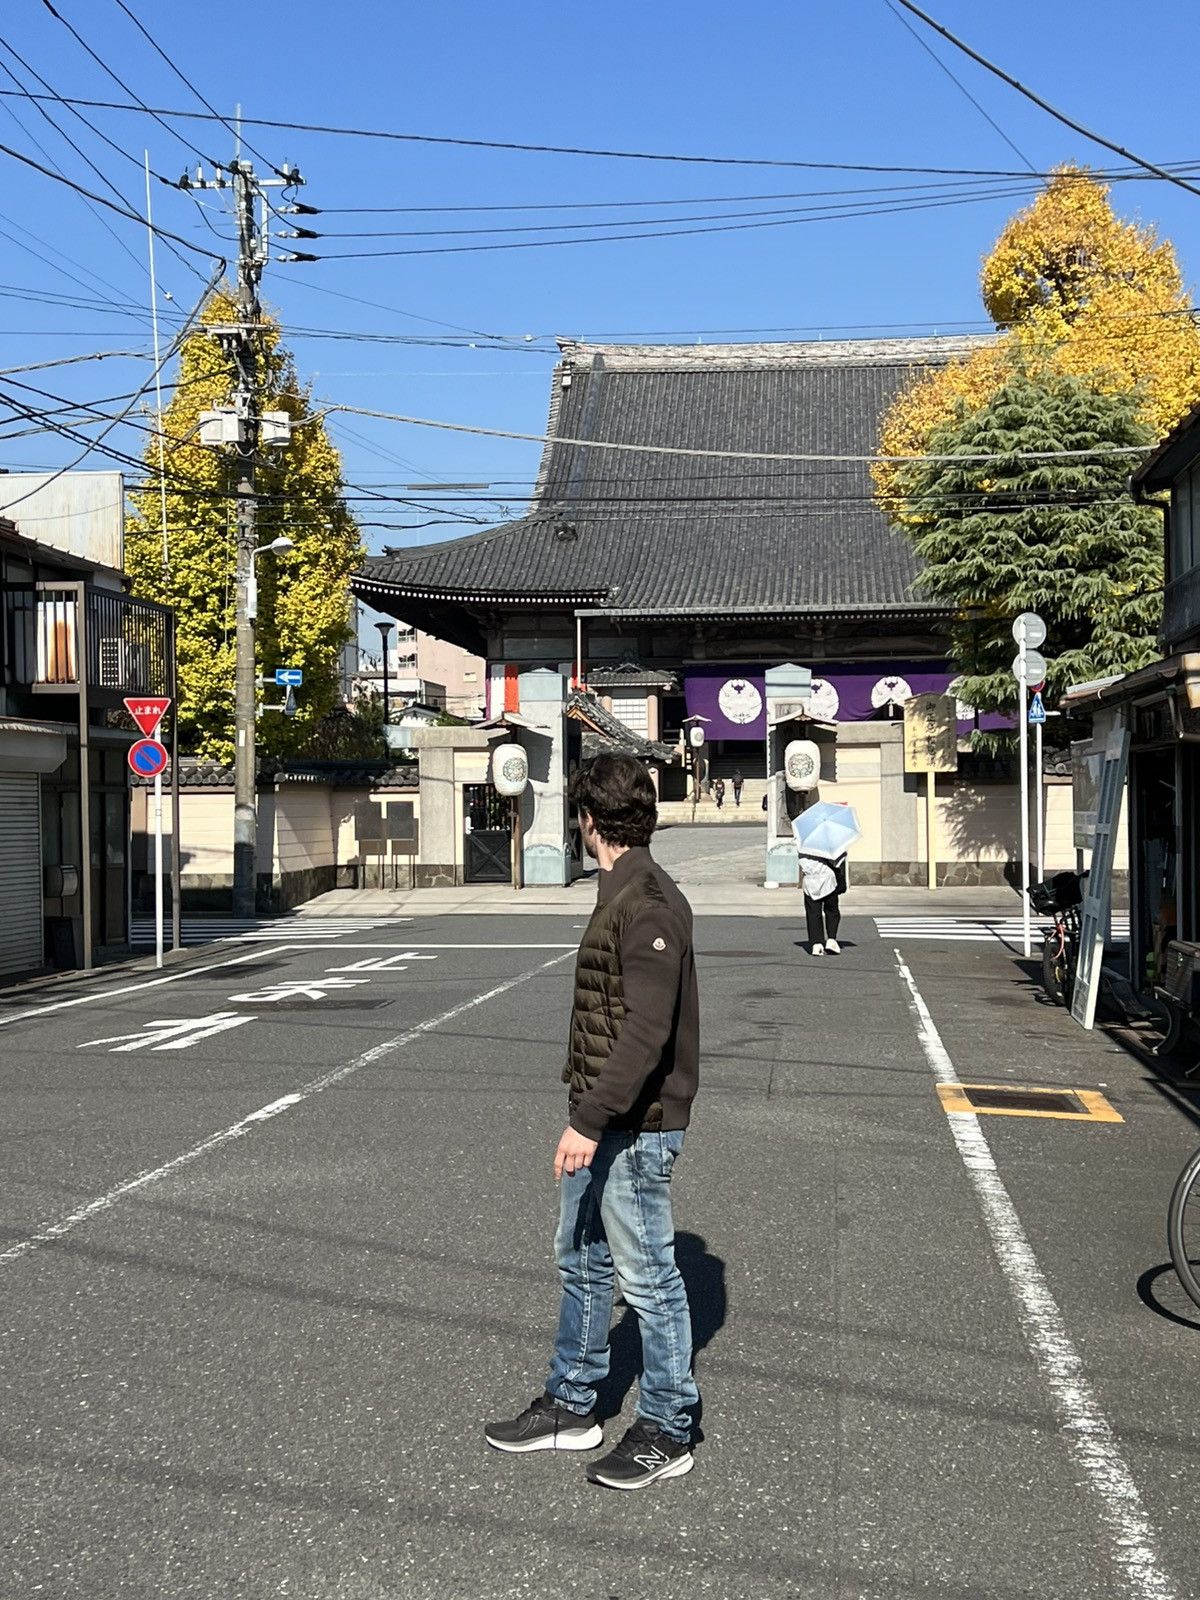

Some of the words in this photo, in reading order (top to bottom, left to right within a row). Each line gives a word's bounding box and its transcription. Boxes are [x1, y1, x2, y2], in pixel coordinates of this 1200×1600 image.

[135, 706, 161, 715] 止まれ
[76, 952, 438, 1052] 止まれ
